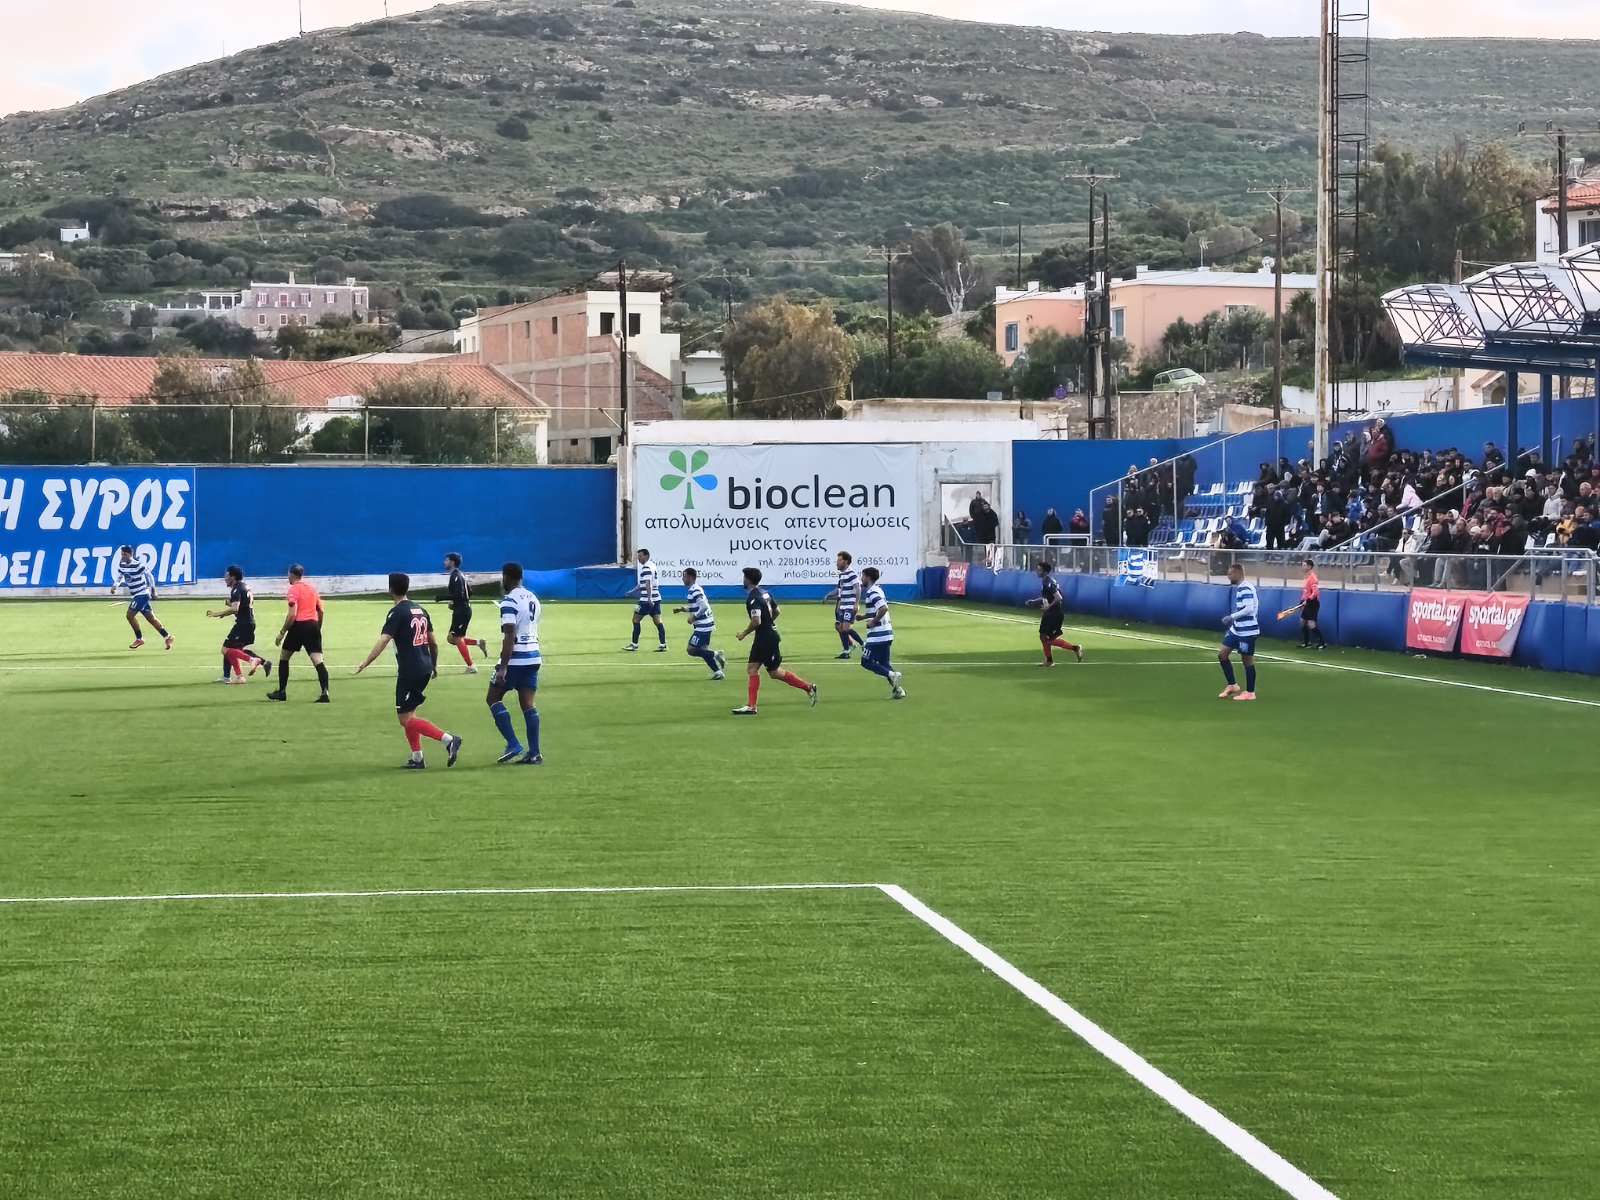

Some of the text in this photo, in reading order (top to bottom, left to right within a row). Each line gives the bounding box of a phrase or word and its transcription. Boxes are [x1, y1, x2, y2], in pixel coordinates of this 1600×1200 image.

[38, 478, 190, 530] ΣΥΡΟΣ
[728, 474, 895, 510] bioclean
[645, 512, 910, 532] απολυμάνσεις απεντομώσεις
[729, 534, 827, 554] μυοκτονίες
[778, 557, 831, 567] 2281043958
[528, 600, 536, 622] 9
[1411, 598, 1460, 626] sportal.gr
[1469, 600, 1522, 629] sportal.gr
